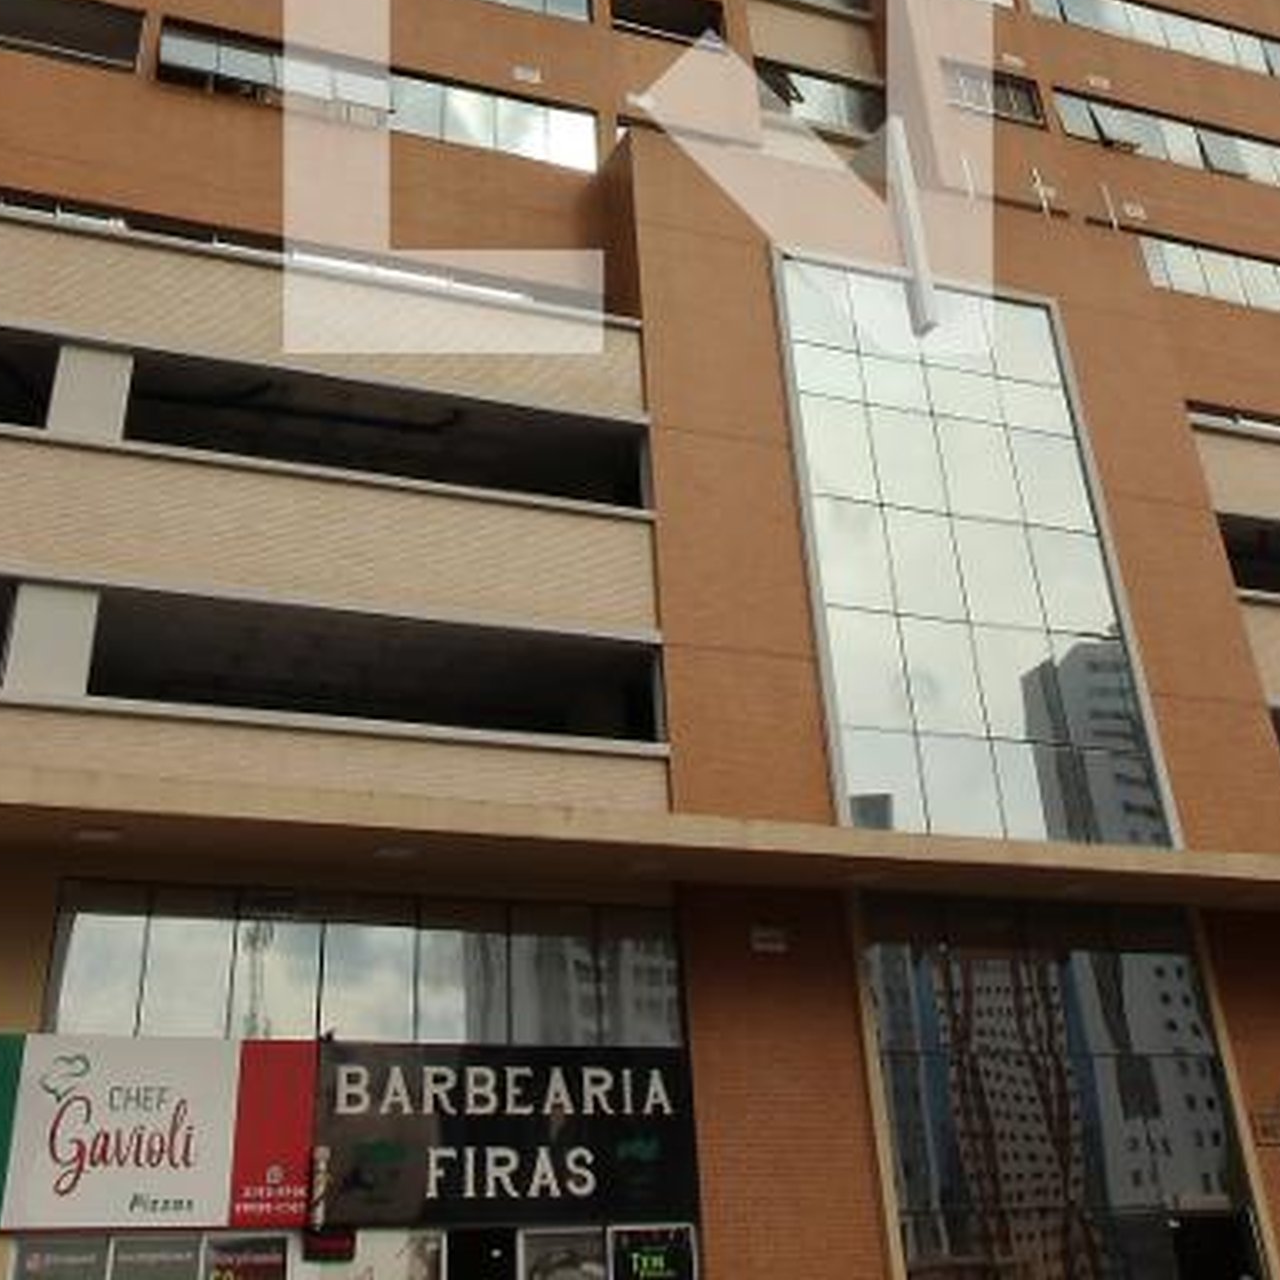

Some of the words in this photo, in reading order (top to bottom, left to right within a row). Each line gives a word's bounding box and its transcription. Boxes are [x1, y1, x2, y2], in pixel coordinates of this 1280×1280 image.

[108, 1085, 173, 1111] CHEF
[334, 1065, 673, 1115] BARBEARIA
[49, 1095, 195, 1197] Gavioli
[425, 1146, 598, 1199] FIRAS
[128, 1193, 194, 1213] Pizzas
